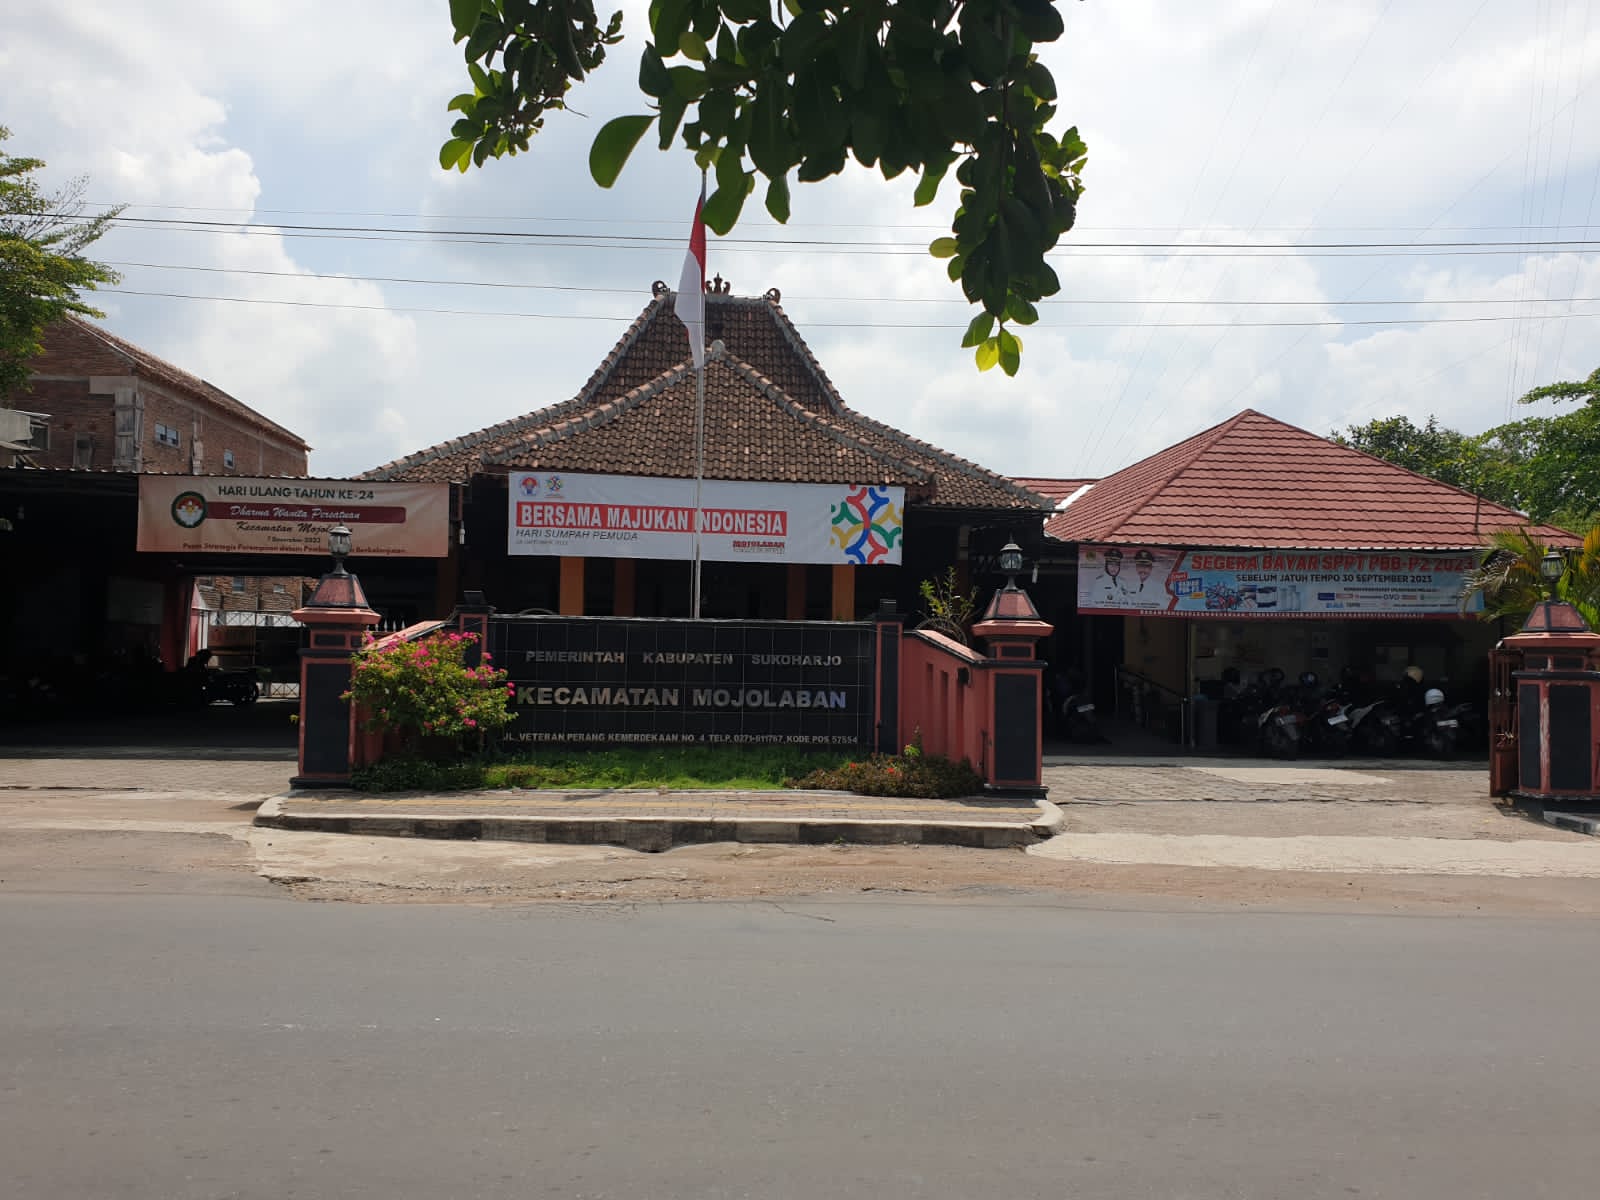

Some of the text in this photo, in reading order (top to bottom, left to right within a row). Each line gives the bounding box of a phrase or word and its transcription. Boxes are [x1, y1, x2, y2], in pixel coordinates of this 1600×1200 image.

[218, 485, 374, 500] HARI ULANG TAHUN KE-24
[230, 504, 270, 517] Dharma
[272, 506, 308, 518] Wanita
[521, 504, 602, 527] BERSAMA
[607, 507, 688, 530] MAJUKAN
[236, 521, 293, 533] Kecamatan
[516, 529, 638, 541] HARI SUMPAH PEMUDA
[1191, 555, 1474, 572] SEGERA BAYAR SPPT PBB-P2 2023
[1236, 574, 1432, 583] SEBELUM JATUH TEMPO 30 SEPTEMBER 2023
[526, 651, 842, 666] PEMERINTAH KABUPATEN SUKOHARJO
[516, 687, 847, 708] KECAMATAN MOJOLABAN
[519, 732, 565, 741] VETERAN
[567, 732, 607, 741] PERANG
[607, 733, 678, 742] KEMERDEKAAN
[787, 735, 810, 743] KODE
[812, 735, 829, 743] POS
